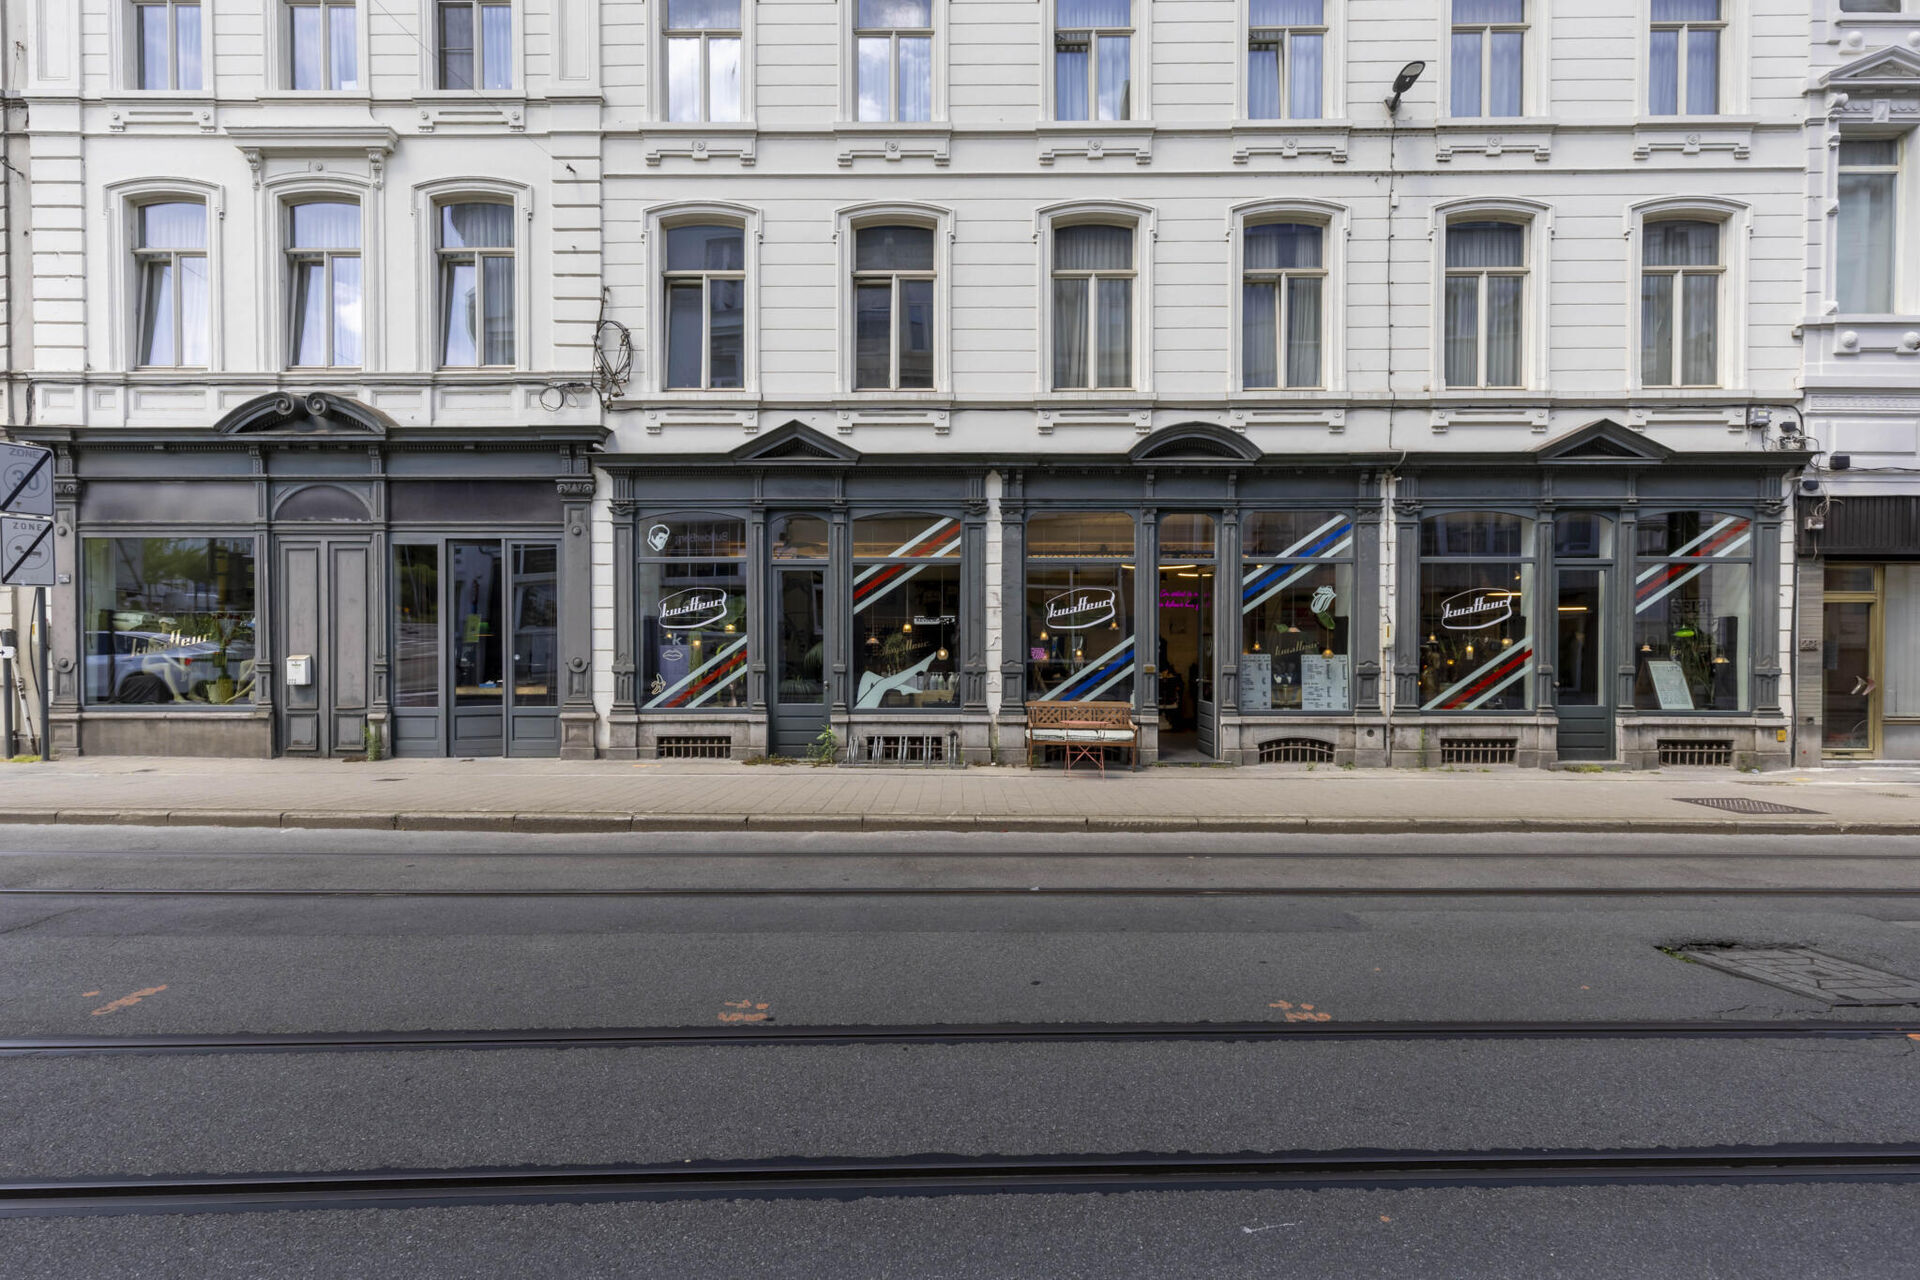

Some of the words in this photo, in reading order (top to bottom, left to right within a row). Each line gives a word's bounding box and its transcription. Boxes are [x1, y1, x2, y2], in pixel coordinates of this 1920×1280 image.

[9, 447, 40, 460] ZONE
[11, 469, 39, 491] 30
[12, 521, 42, 532] ZONE
[661, 596, 723, 618] kwaffeur
[1049, 596, 1112, 618] kwaffeur
[1444, 596, 1509, 618] kwaffeur
